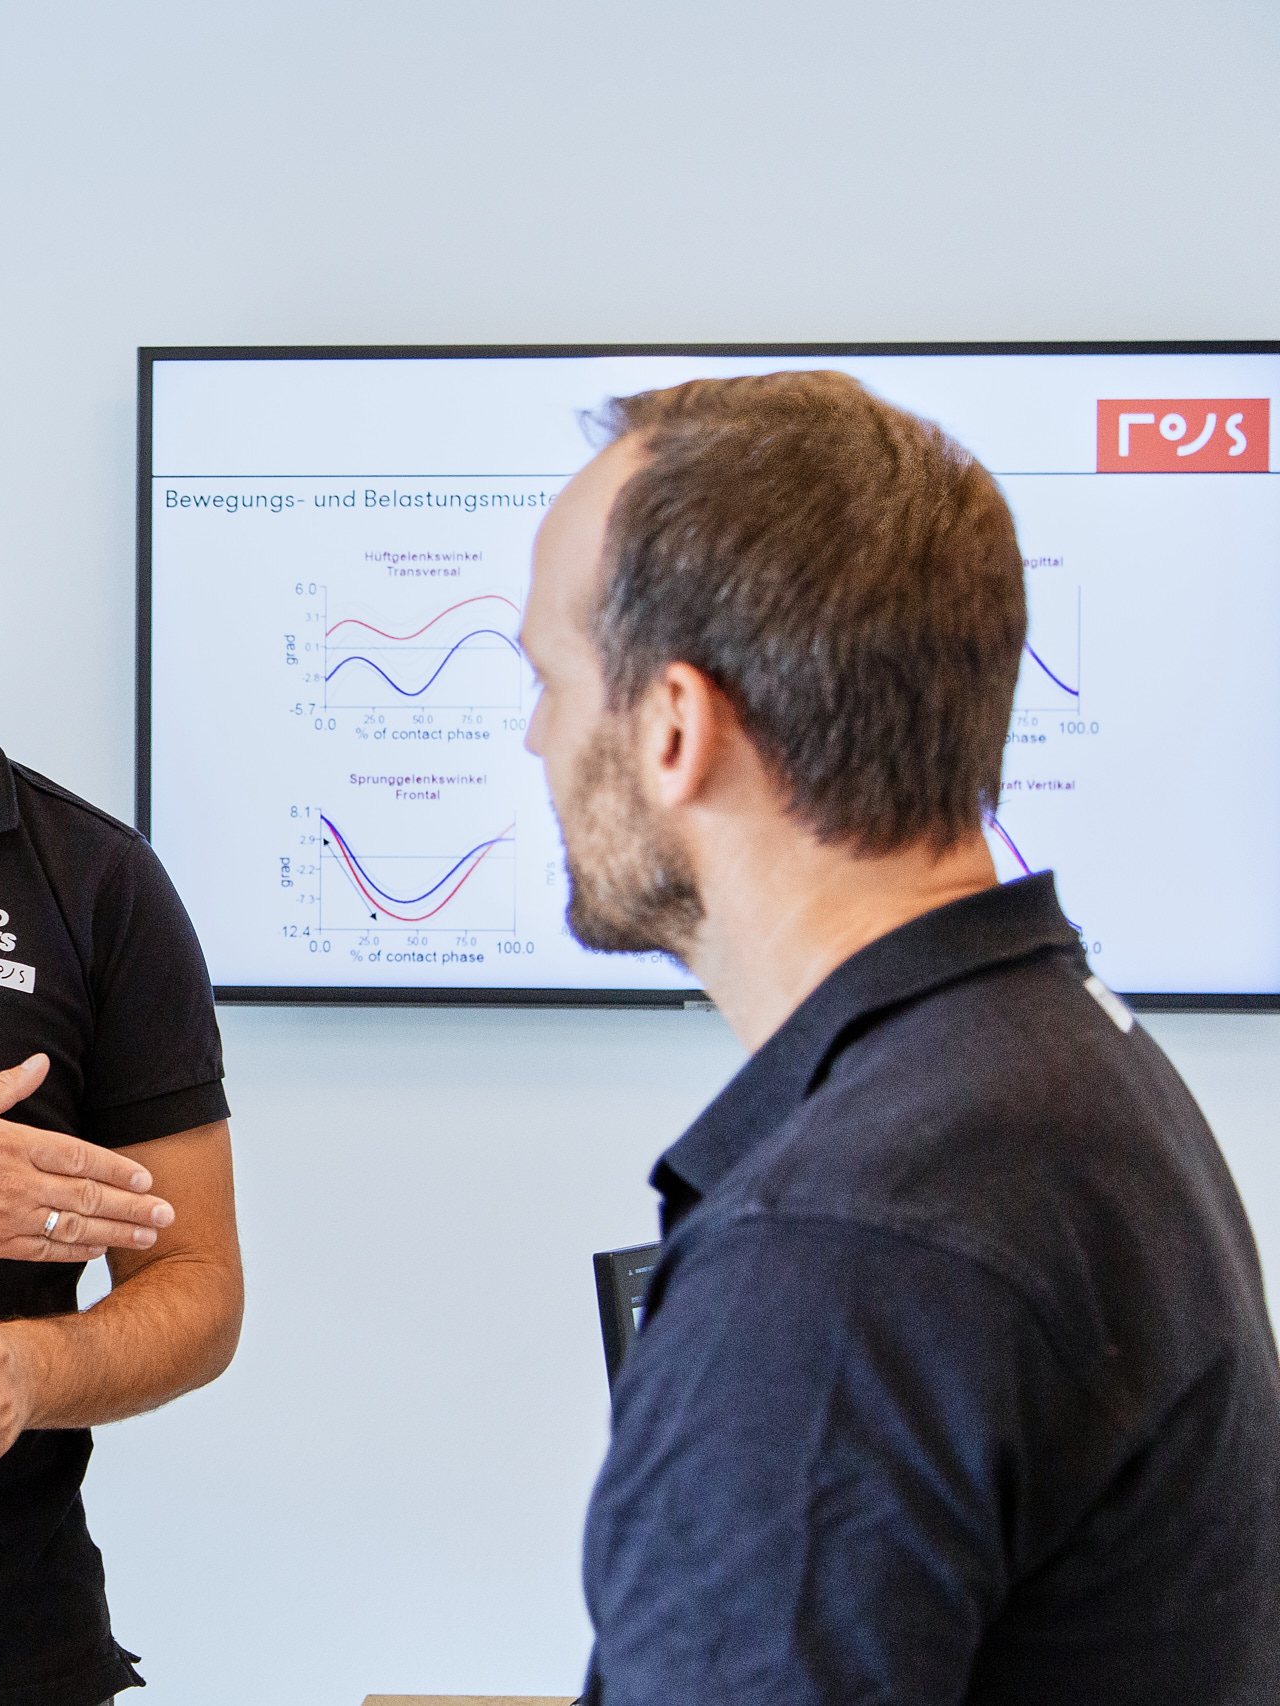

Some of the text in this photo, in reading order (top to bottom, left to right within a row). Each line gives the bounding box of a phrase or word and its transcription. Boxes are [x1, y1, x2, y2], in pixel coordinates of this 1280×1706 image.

[165, 489, 558, 513] Bewegungs- und Belastungsmuste
[1022, 556, 1064, 568] agittal
[387, 566, 461, 577] Transversal
[295, 582, 317, 596] 6.0
[284, 634, 299, 666] grad
[290, 702, 317, 716] -5.7
[314, 718, 337, 731] 0.0
[364, 715, 483, 725] 25.0 50.0 75.0
[1059, 721, 1100, 735] 100.0
[355, 727, 491, 743] % of contact phase
[349, 773, 488, 786] Sprunggelenkswinkel
[1027, 780, 1076, 790] Vertikal
[395, 789, 441, 800] Frontal
[290, 805, 311, 818] 8.1
[279, 856, 294, 888] grad
[309, 940, 535, 954] 0.0 100.0
[358, 936, 477, 947] 25.0 50.0 75.0
[350, 949, 485, 966] % of contact phase
